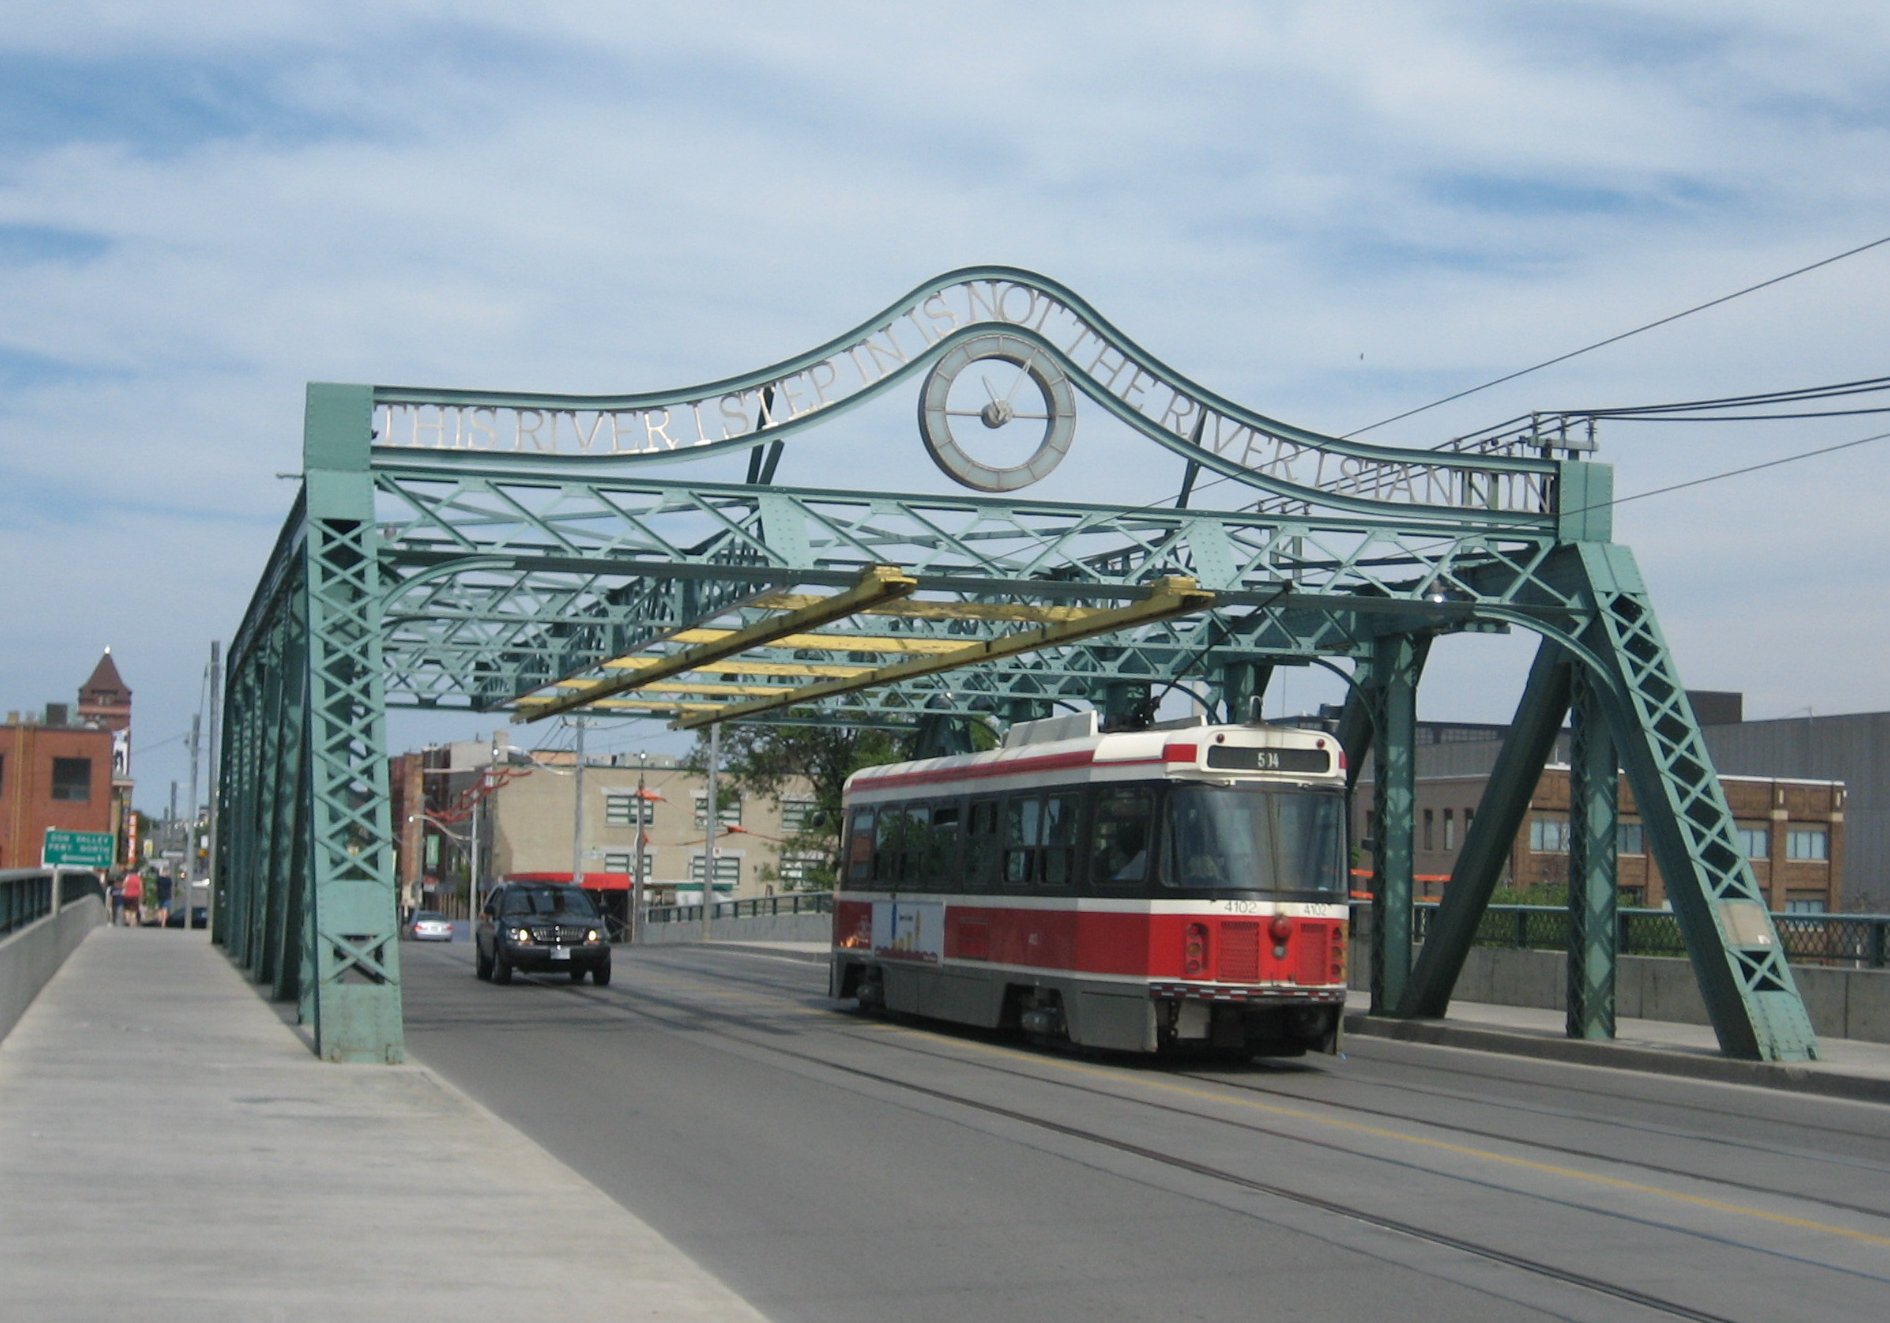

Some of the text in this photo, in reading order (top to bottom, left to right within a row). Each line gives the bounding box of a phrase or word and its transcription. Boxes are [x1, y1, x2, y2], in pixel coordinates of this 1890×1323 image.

[374, 279, 1555, 514] THIS RIVER I STEP IN IS NOT THE RIVER I STAND IN
[1224, 902, 1257, 913] 4102
[1304, 904, 1327, 915] 4102
